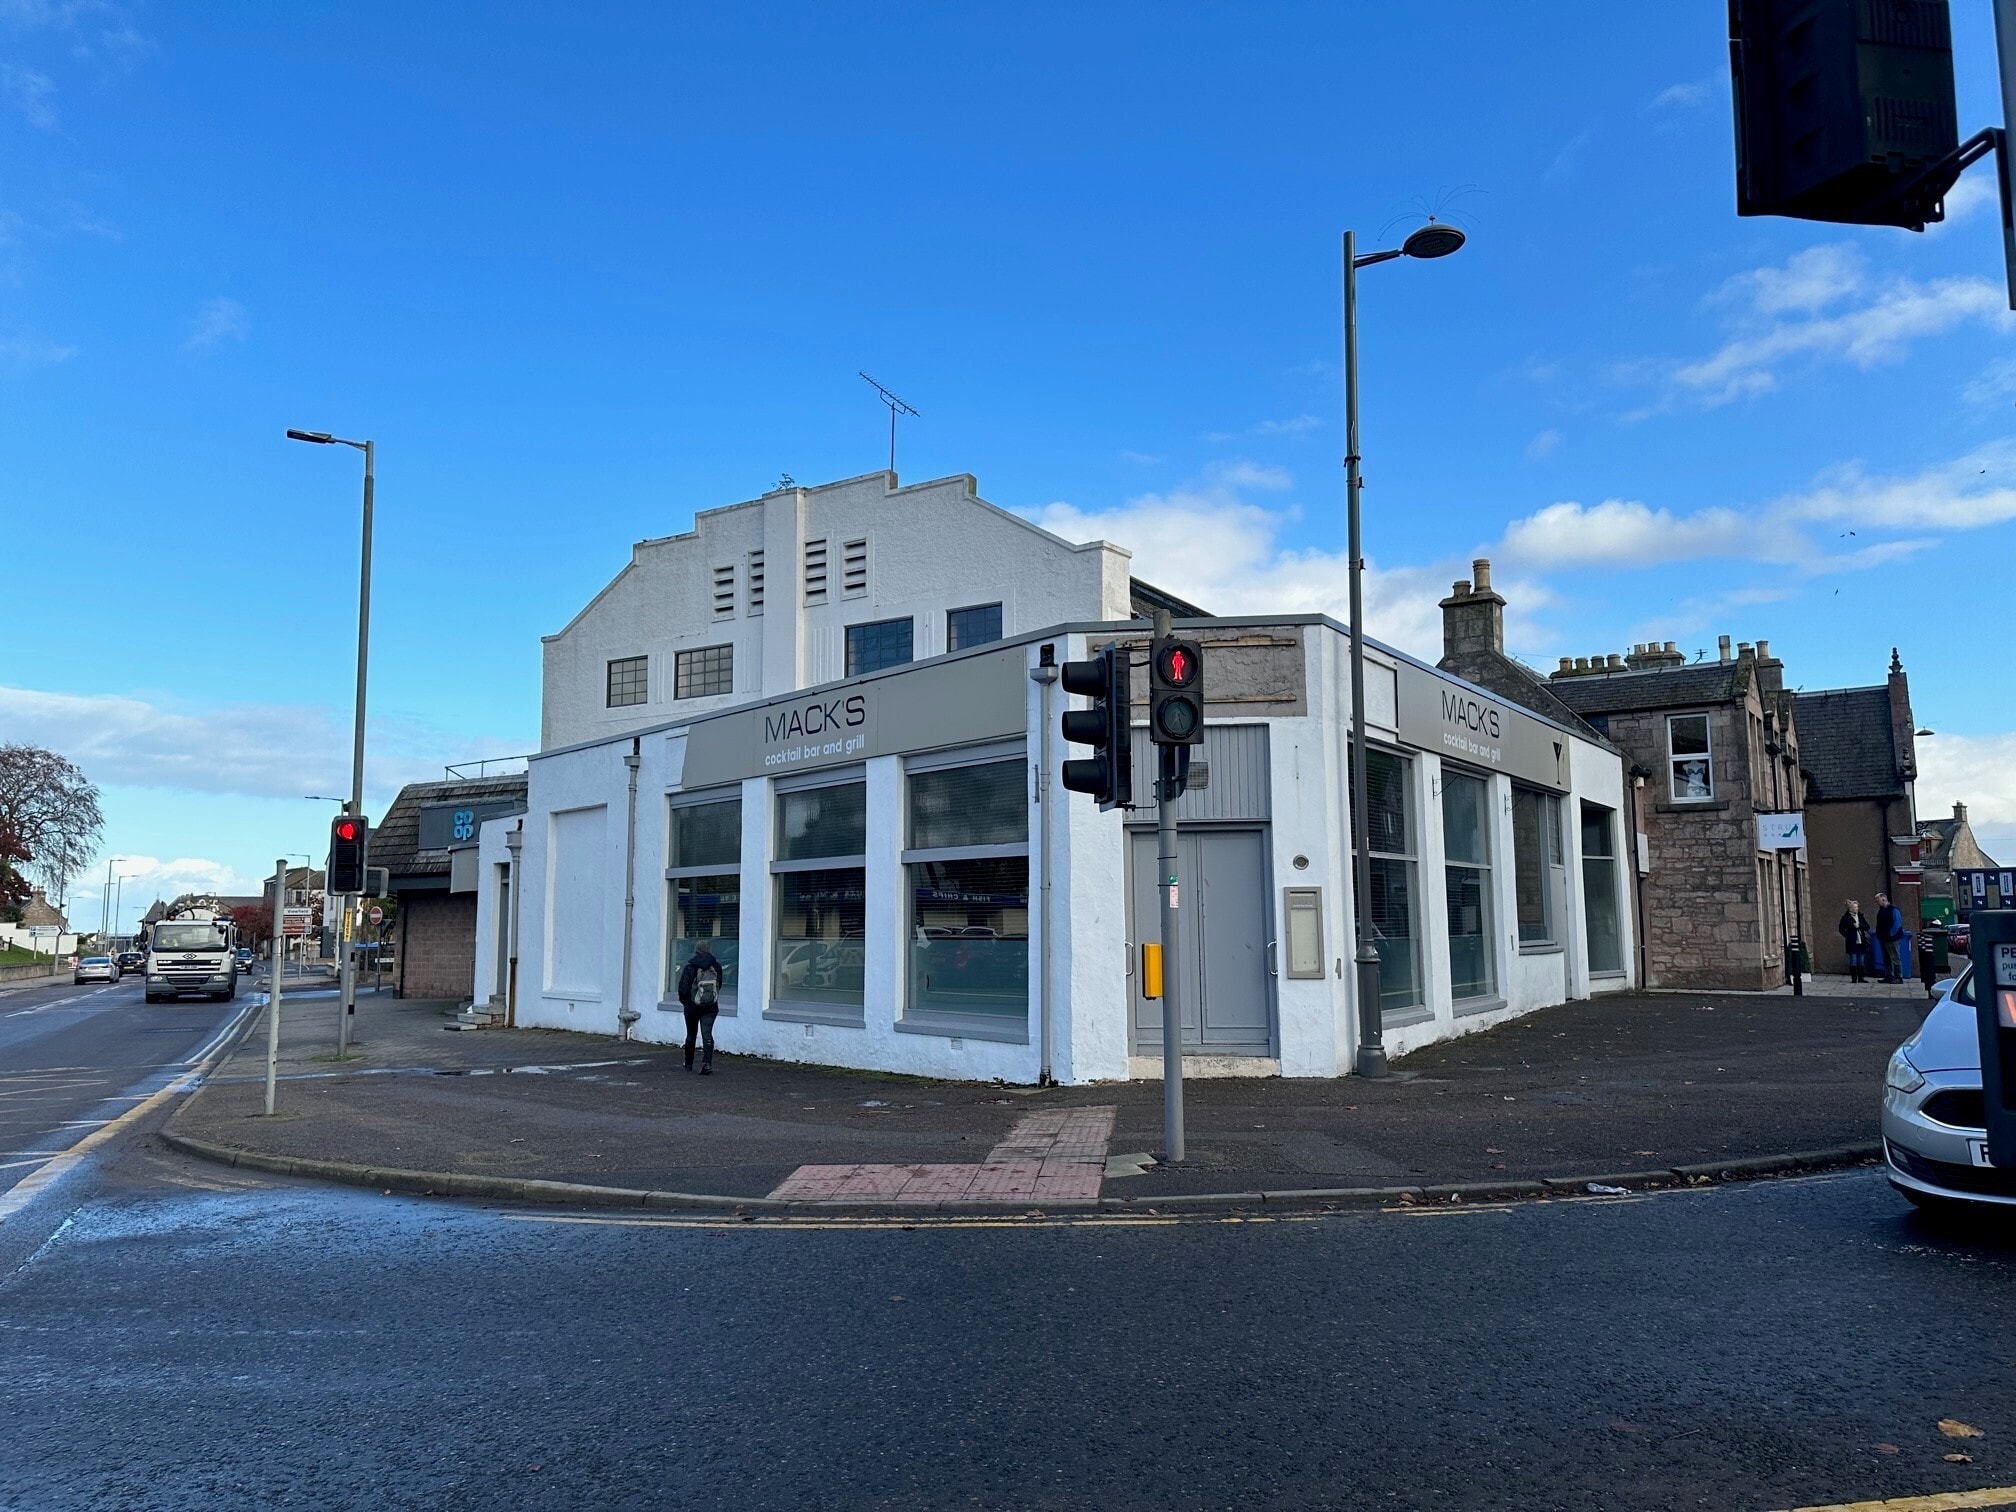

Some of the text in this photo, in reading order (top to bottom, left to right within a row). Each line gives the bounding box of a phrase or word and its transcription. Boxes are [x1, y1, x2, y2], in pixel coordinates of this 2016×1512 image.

[765, 695, 865, 743] MACK'S
[1442, 690, 1500, 739] MACK'S
[765, 734, 865, 766] cocktail bar and grill
[1443, 732, 1501, 764] cocktail bar and grill
